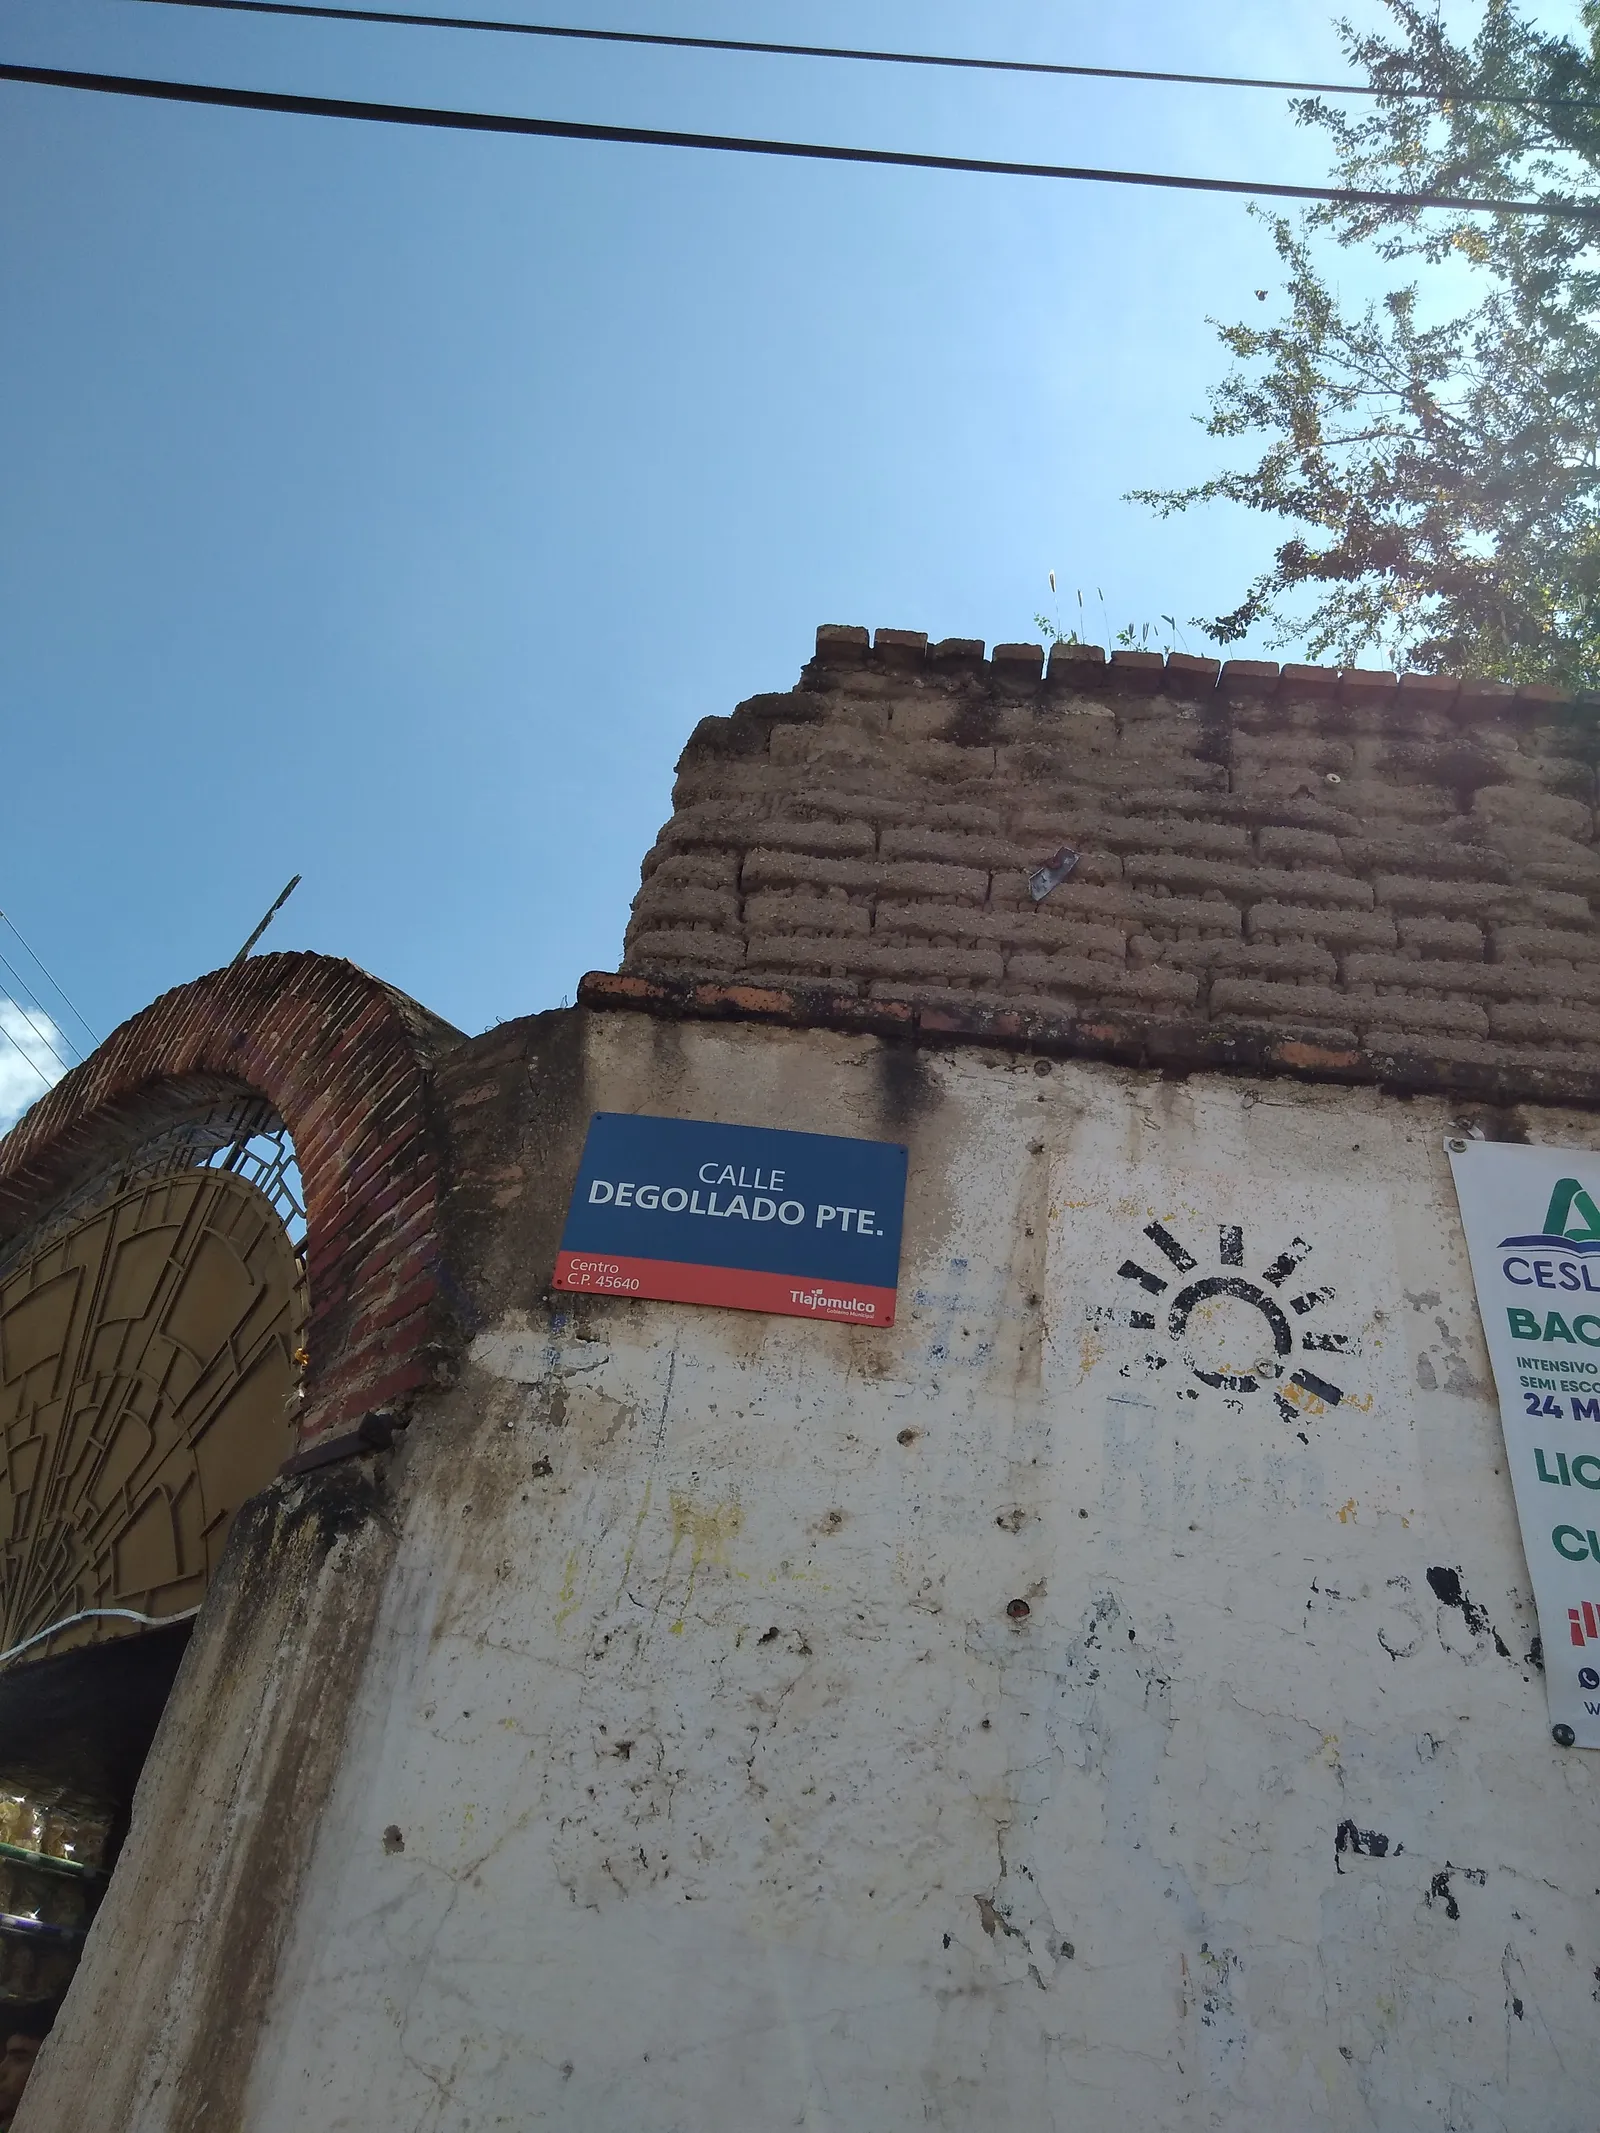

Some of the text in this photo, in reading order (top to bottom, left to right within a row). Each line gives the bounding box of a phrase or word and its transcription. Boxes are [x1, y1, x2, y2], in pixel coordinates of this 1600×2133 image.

[699, 1163, 786, 1192] CALLE
[588, 1180, 884, 1236] DEGOLLADO PTE.
[570, 1258, 619, 1274] Centro
[567, 1273, 640, 1290] C.P. 45640
[790, 1290, 876, 1313] Tlajomulco
[826, 1308, 875, 1319] Gobierno Municipal
[1516, 1356, 1598, 1374] INTENSIVO
[1520, 1375, 1556, 1391] SEMI
[1523, 1392, 1564, 1419] 24
